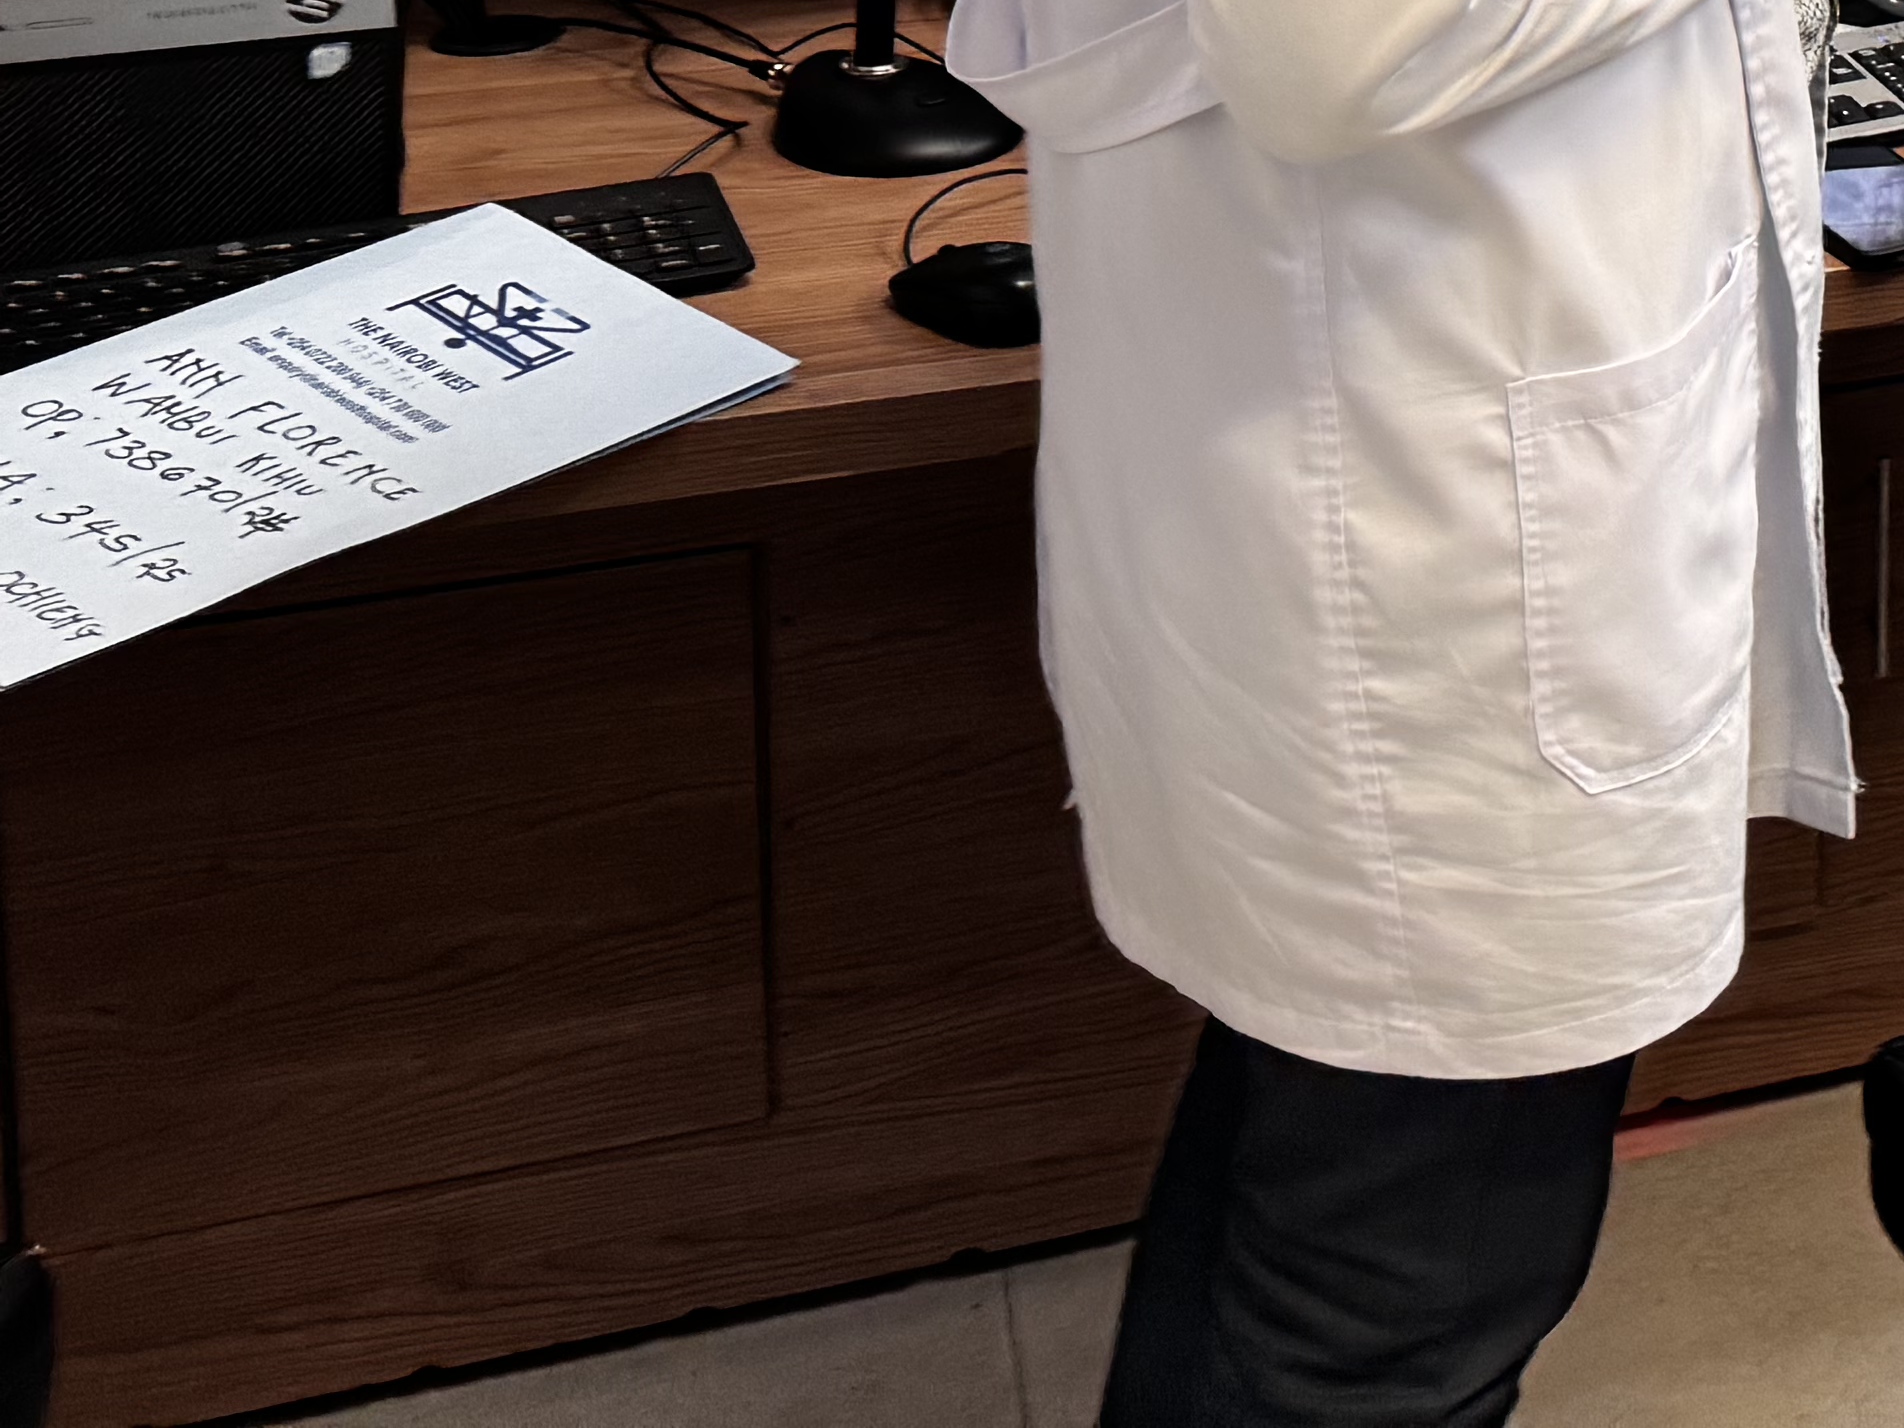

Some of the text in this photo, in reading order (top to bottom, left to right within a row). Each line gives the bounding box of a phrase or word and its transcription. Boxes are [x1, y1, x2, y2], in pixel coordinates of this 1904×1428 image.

[348, 317, 480, 394] THE NAIROBI WEST
[92, 373, 239, 445] WAMBUI
[234, 452, 325, 497] KIHIU
[144, 348, 245, 399] ANN
[227, 401, 422, 503] FLORENCE
[35, 504, 191, 582] 345/25
